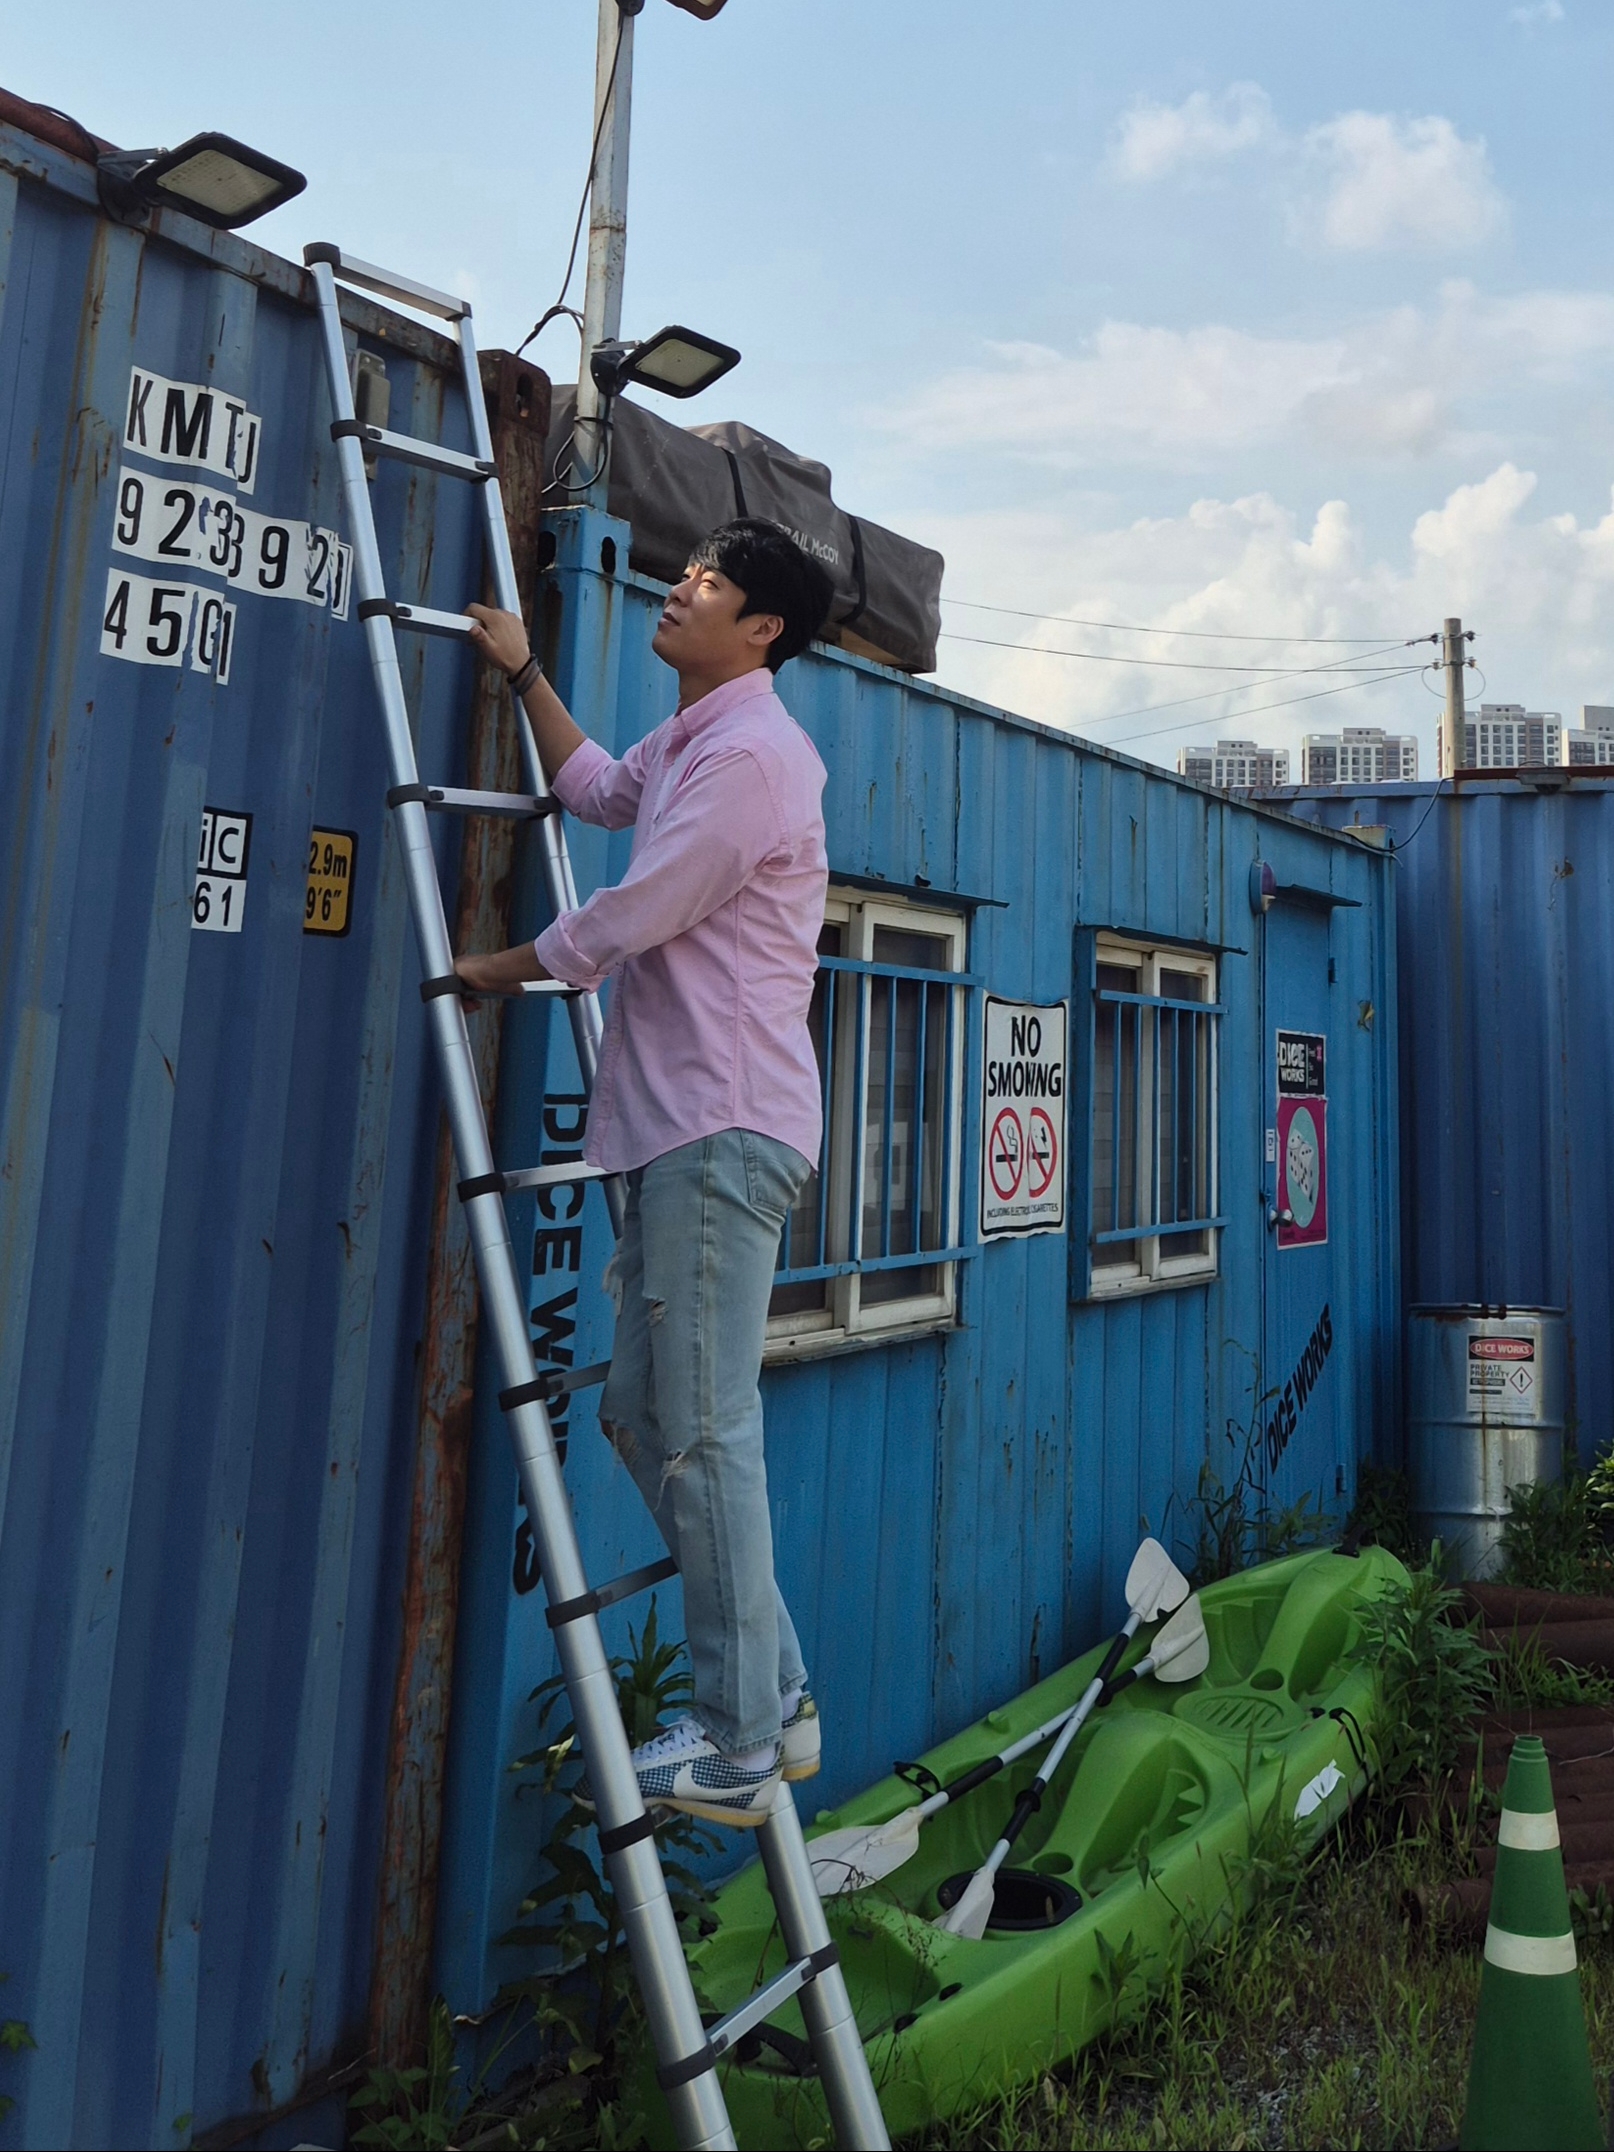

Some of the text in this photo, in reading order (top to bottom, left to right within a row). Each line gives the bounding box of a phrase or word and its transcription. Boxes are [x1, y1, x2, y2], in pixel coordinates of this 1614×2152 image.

[193, 881, 233, 927] 61
[1011, 1015, 1041, 1057] NO
[1280, 1041, 1305, 1068] DICE
[533, 1094, 590, 1276] DICE
[1498, 1345, 1530, 1354] WORKS
[1268, 1380, 1297, 1475] DICE
